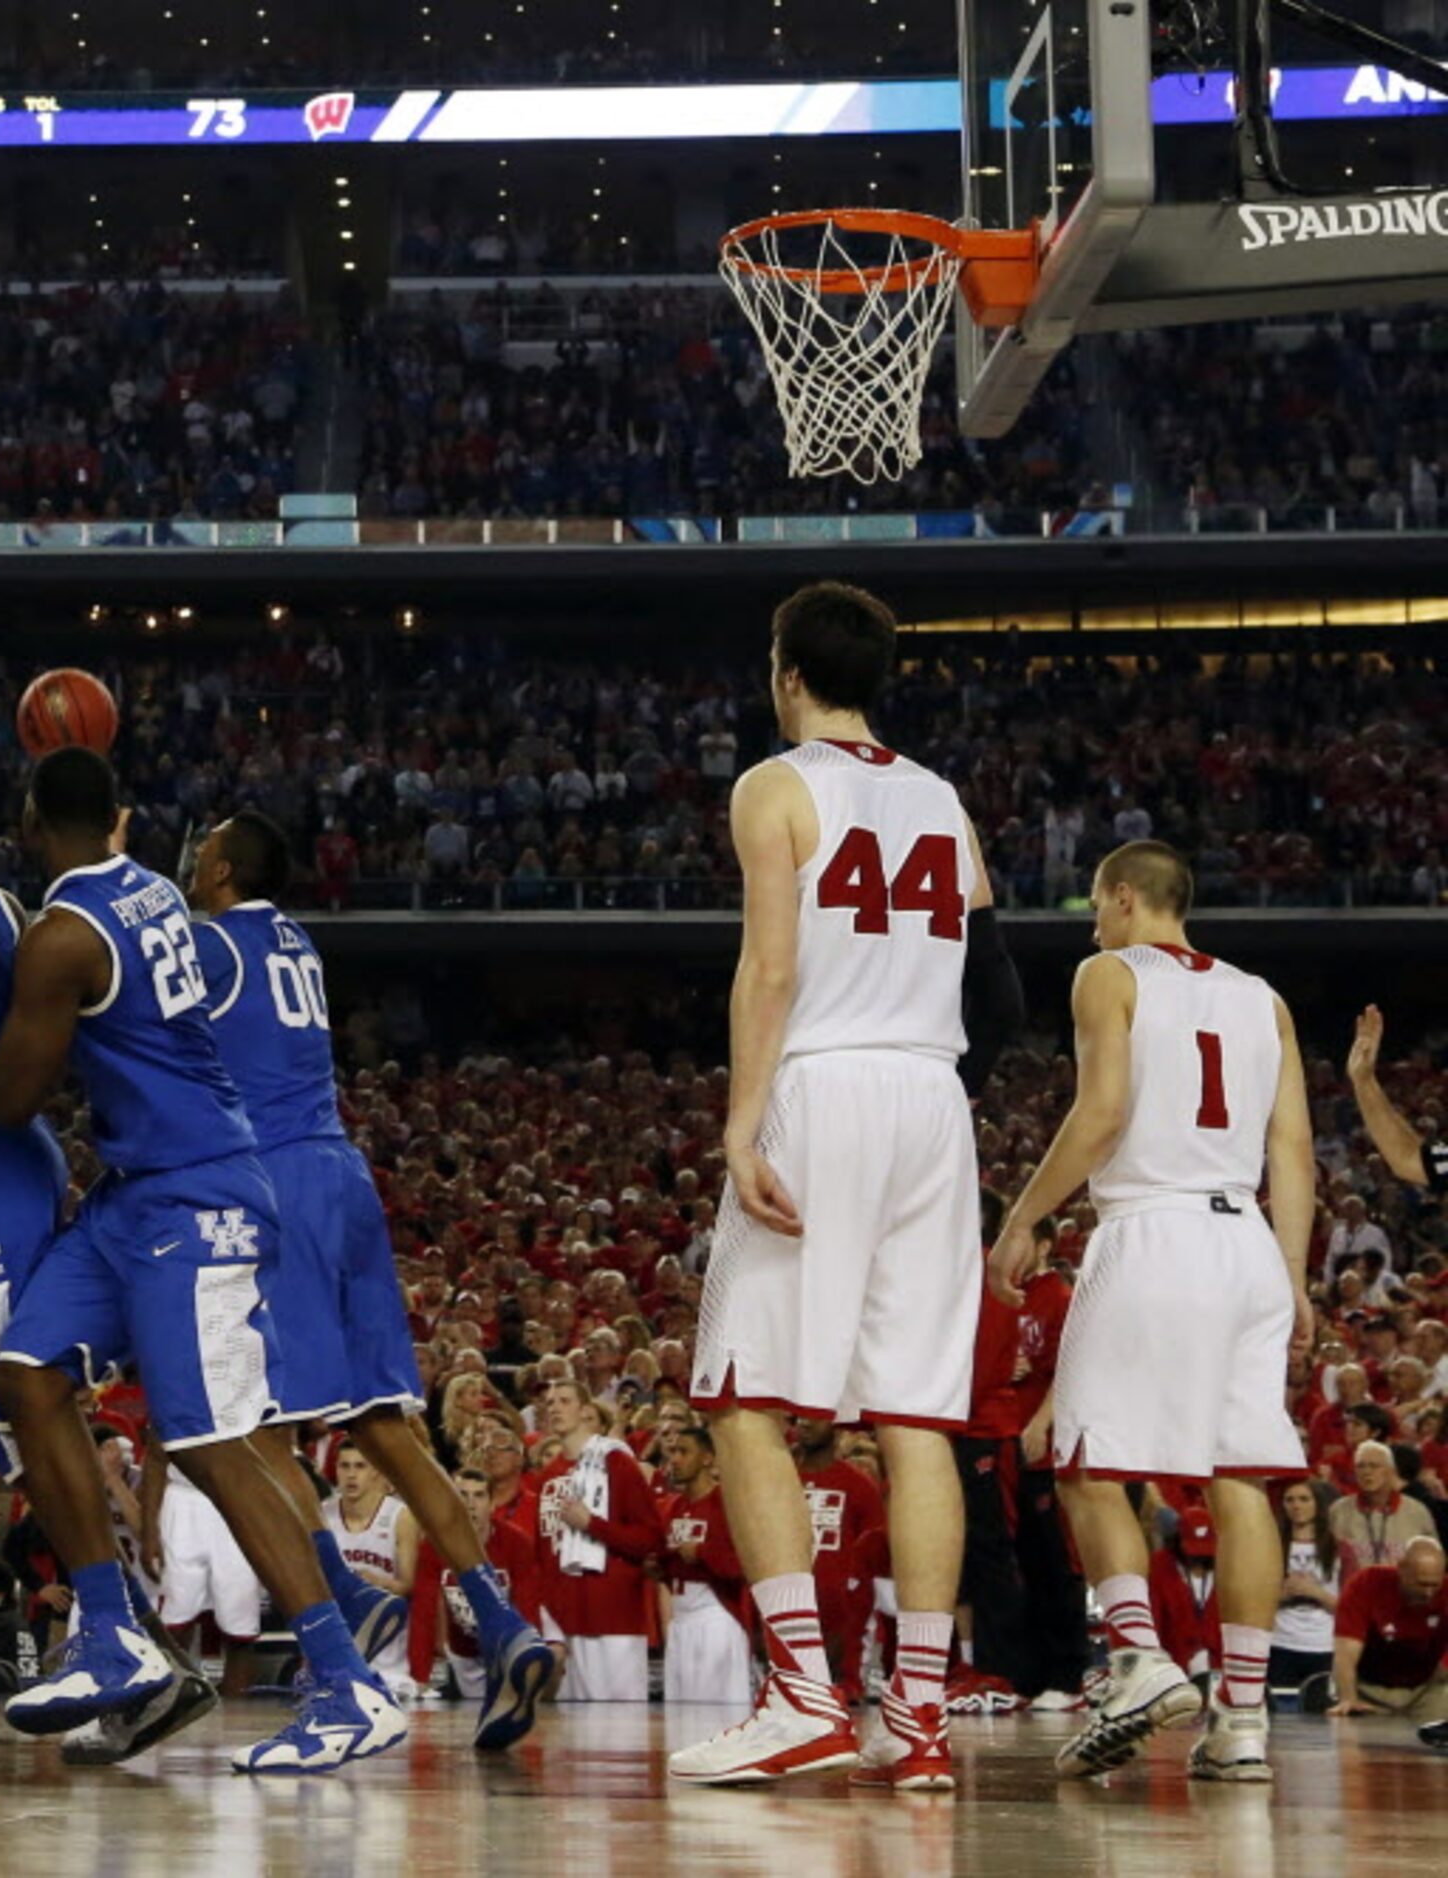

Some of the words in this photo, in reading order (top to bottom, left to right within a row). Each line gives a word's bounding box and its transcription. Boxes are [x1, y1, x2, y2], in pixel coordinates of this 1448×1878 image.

[24, 96, 62, 111] TOL
[1343, 65, 1448, 104] AN
[36, 112, 54, 141] 1
[186, 99, 247, 138] 73
[1238, 191, 1448, 250] SPALDING
[817, 826, 965, 942] 44
[140, 910, 208, 1022] 22
[265, 952, 331, 1030] 00
[1195, 1030, 1229, 1129] 1
[195, 1207, 259, 1259] UK
